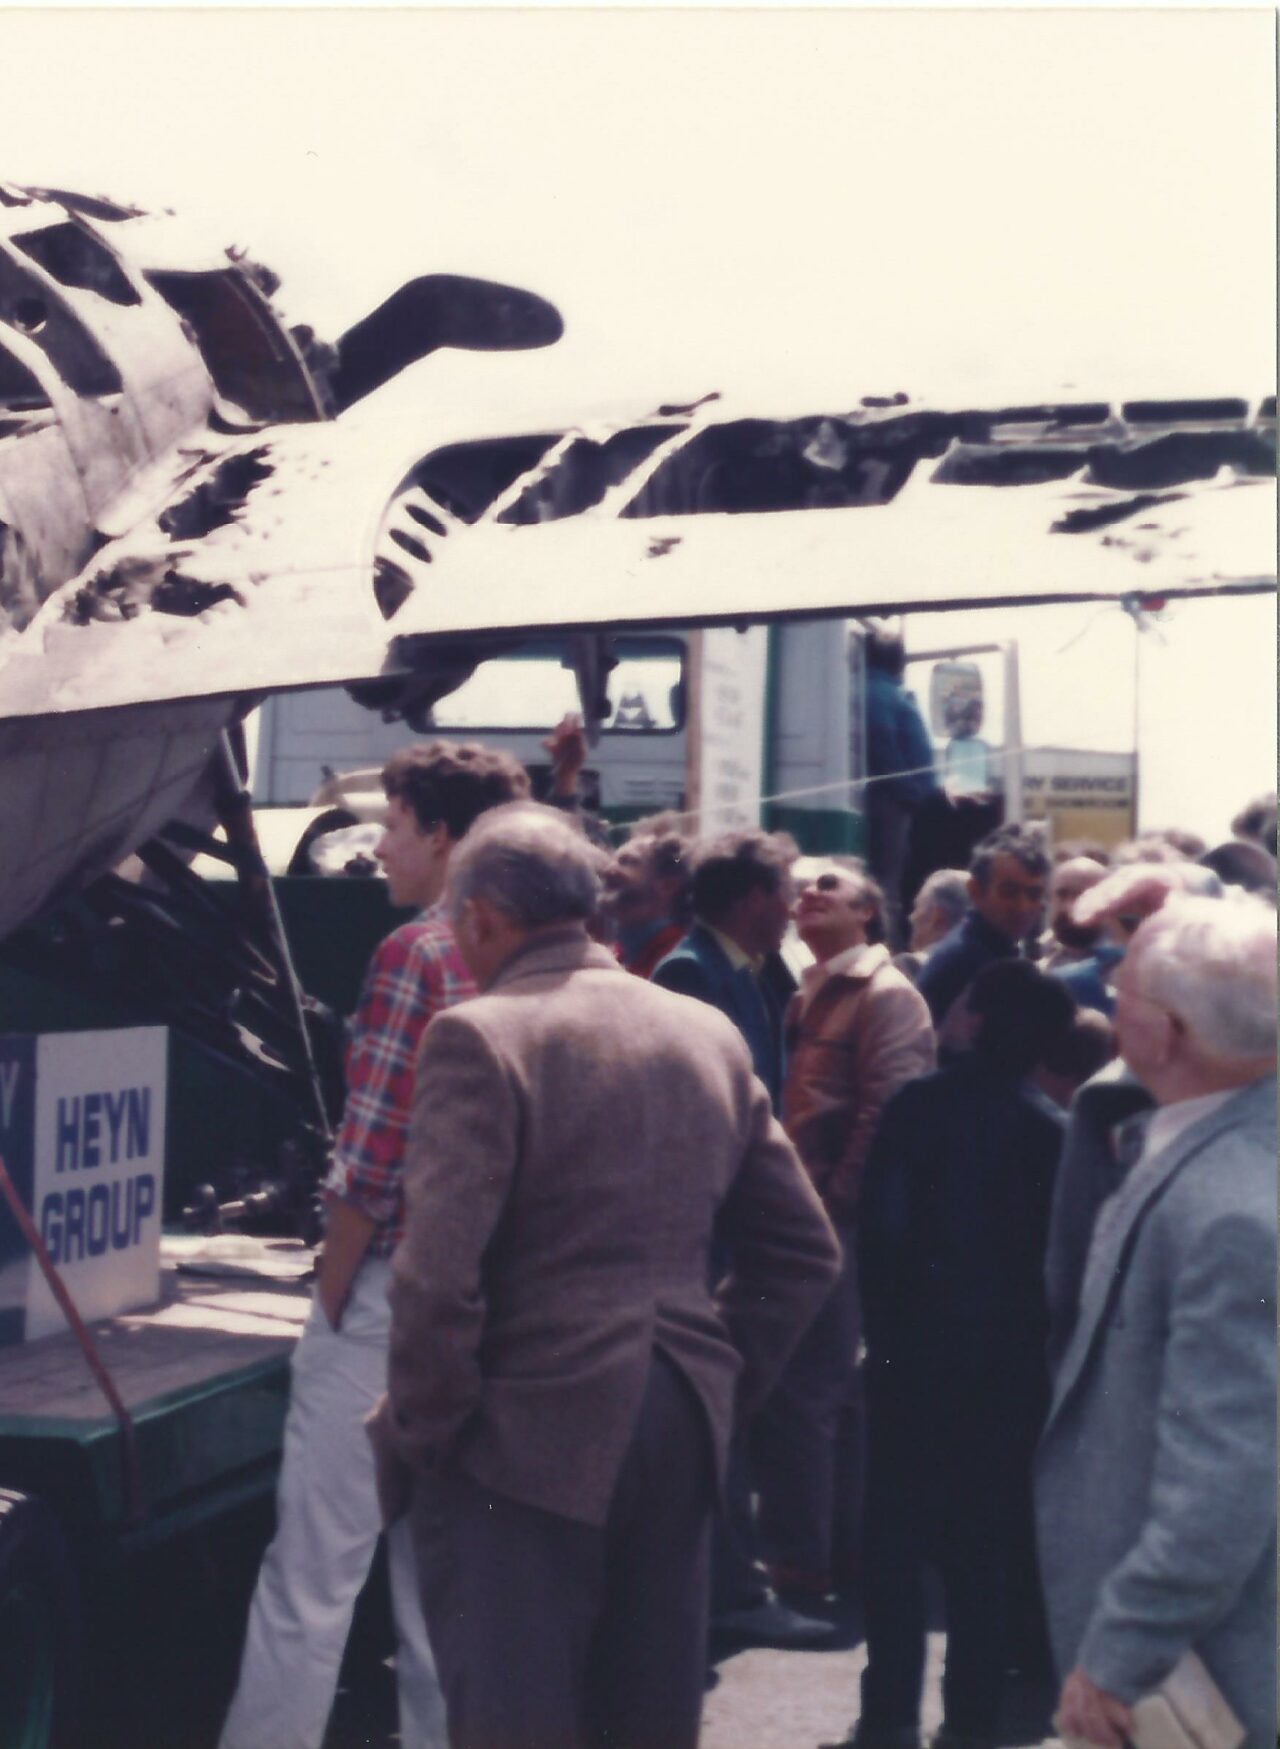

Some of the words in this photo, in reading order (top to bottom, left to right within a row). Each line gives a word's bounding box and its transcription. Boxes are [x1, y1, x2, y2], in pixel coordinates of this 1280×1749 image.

[1051, 776, 1128, 791] SERVICE
[57, 1088, 149, 1171] HEYN
[41, 1175, 154, 1264] GROUP
